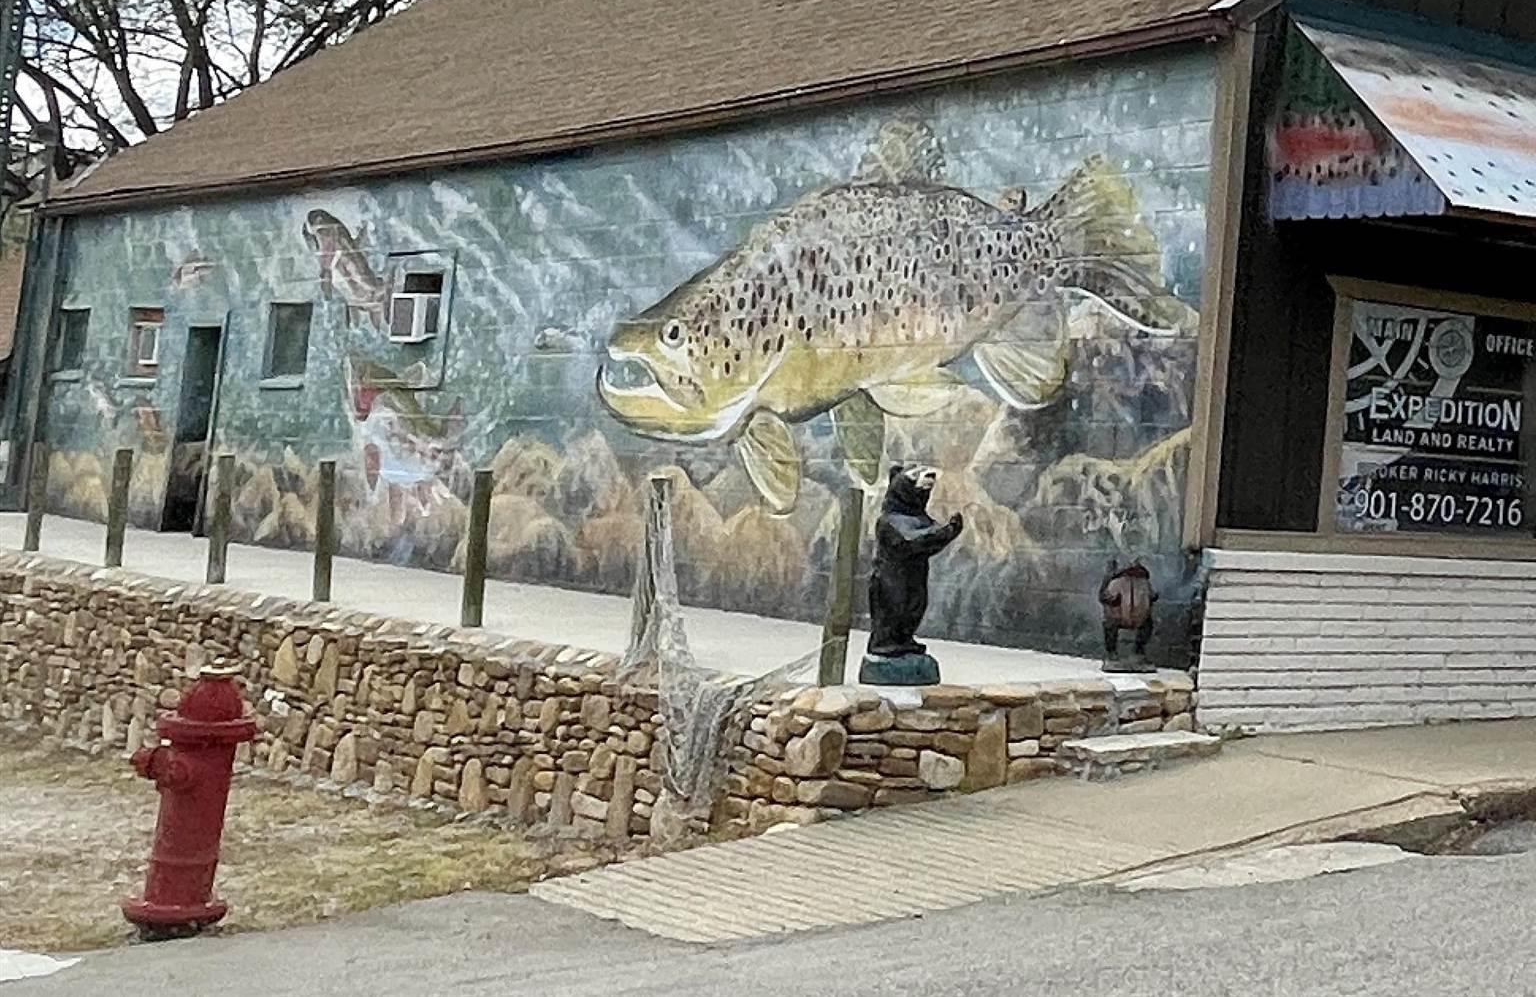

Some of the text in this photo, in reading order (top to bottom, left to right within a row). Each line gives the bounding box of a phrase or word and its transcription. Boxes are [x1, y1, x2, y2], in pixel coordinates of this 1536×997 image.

[1486, 333, 1534, 357] OFFICE
[1368, 386, 1521, 432] EXPEDITION
[1372, 427, 1514, 453] LAND AND REALTY
[1362, 464, 1524, 490] OKER RICKY HARRIS
[1354, 489, 1523, 528] 901-870-7216
